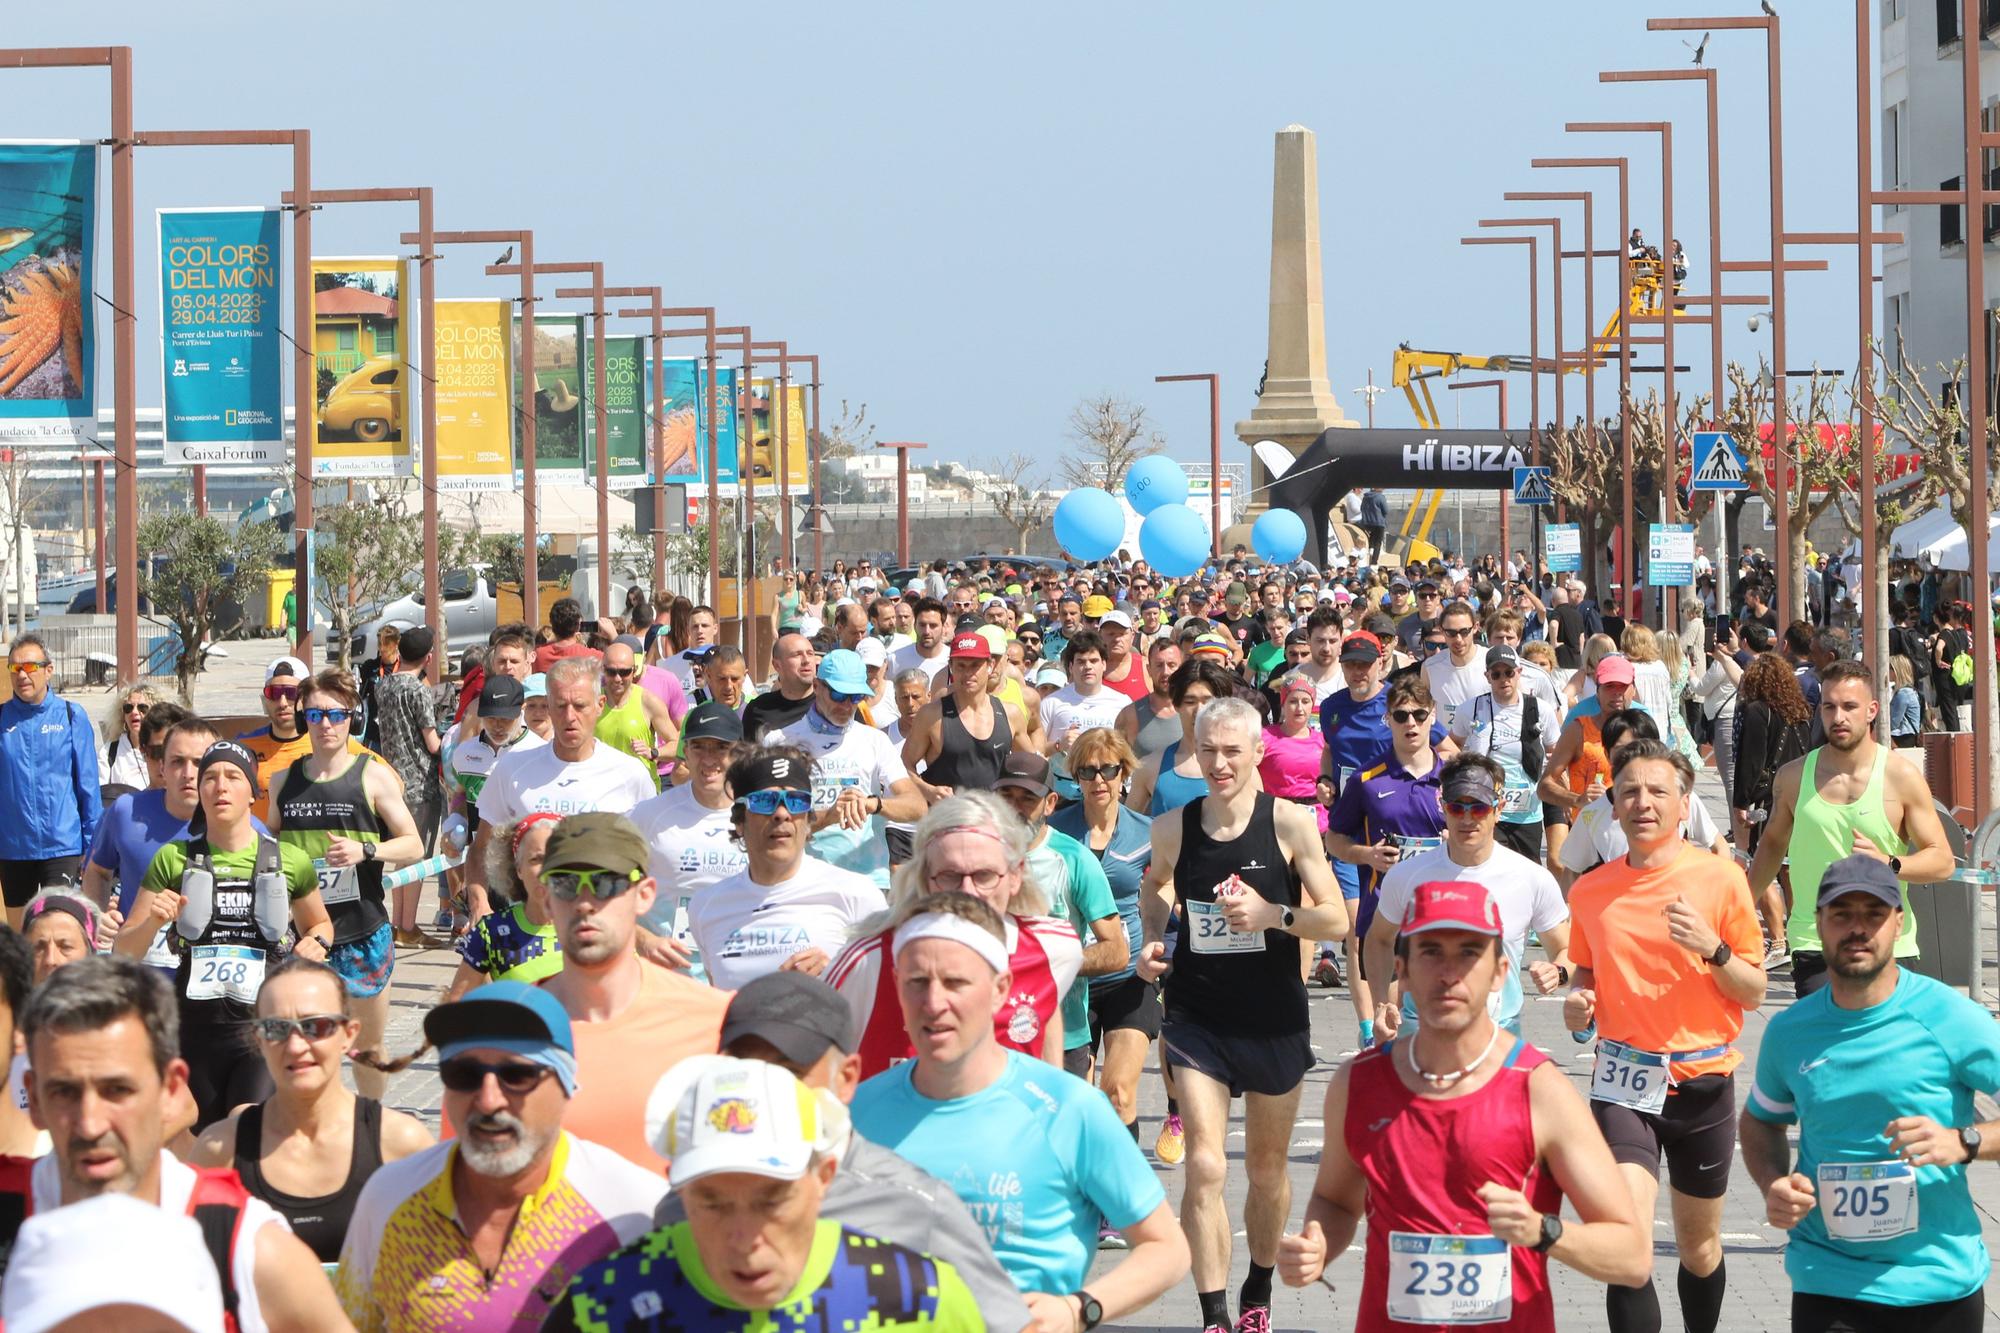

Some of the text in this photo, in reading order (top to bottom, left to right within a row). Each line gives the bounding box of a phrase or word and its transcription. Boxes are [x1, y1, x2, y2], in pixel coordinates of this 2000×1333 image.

[169, 244, 270, 267] COLORS
[171, 268, 215, 289] DEL
[171, 293, 267, 309] 05.04.2023-
[171, 309, 261, 325] 29.04.2023
[172, 331, 197, 339] Carrer
[226, 329, 239, 338] Tur
[244, 329, 263, 337] Palau
[238, 417, 273, 425] GEOGRAPHIC
[183, 446, 267, 460] CaixaForum
[1441, 445, 1527, 471] IBIZA
[284, 809, 322, 817] NOLAN
[703, 851, 749, 865] IBIZA
[749, 928, 810, 946] IBIZA
[200, 960, 247, 984] 268
[1601, 1060, 1649, 1091] 316
[988, 1171, 1022, 1200] life
[1832, 1185, 1889, 1217] 205
[1405, 1261, 1482, 1297] 238
[1451, 1299, 1494, 1310] JUANITO
